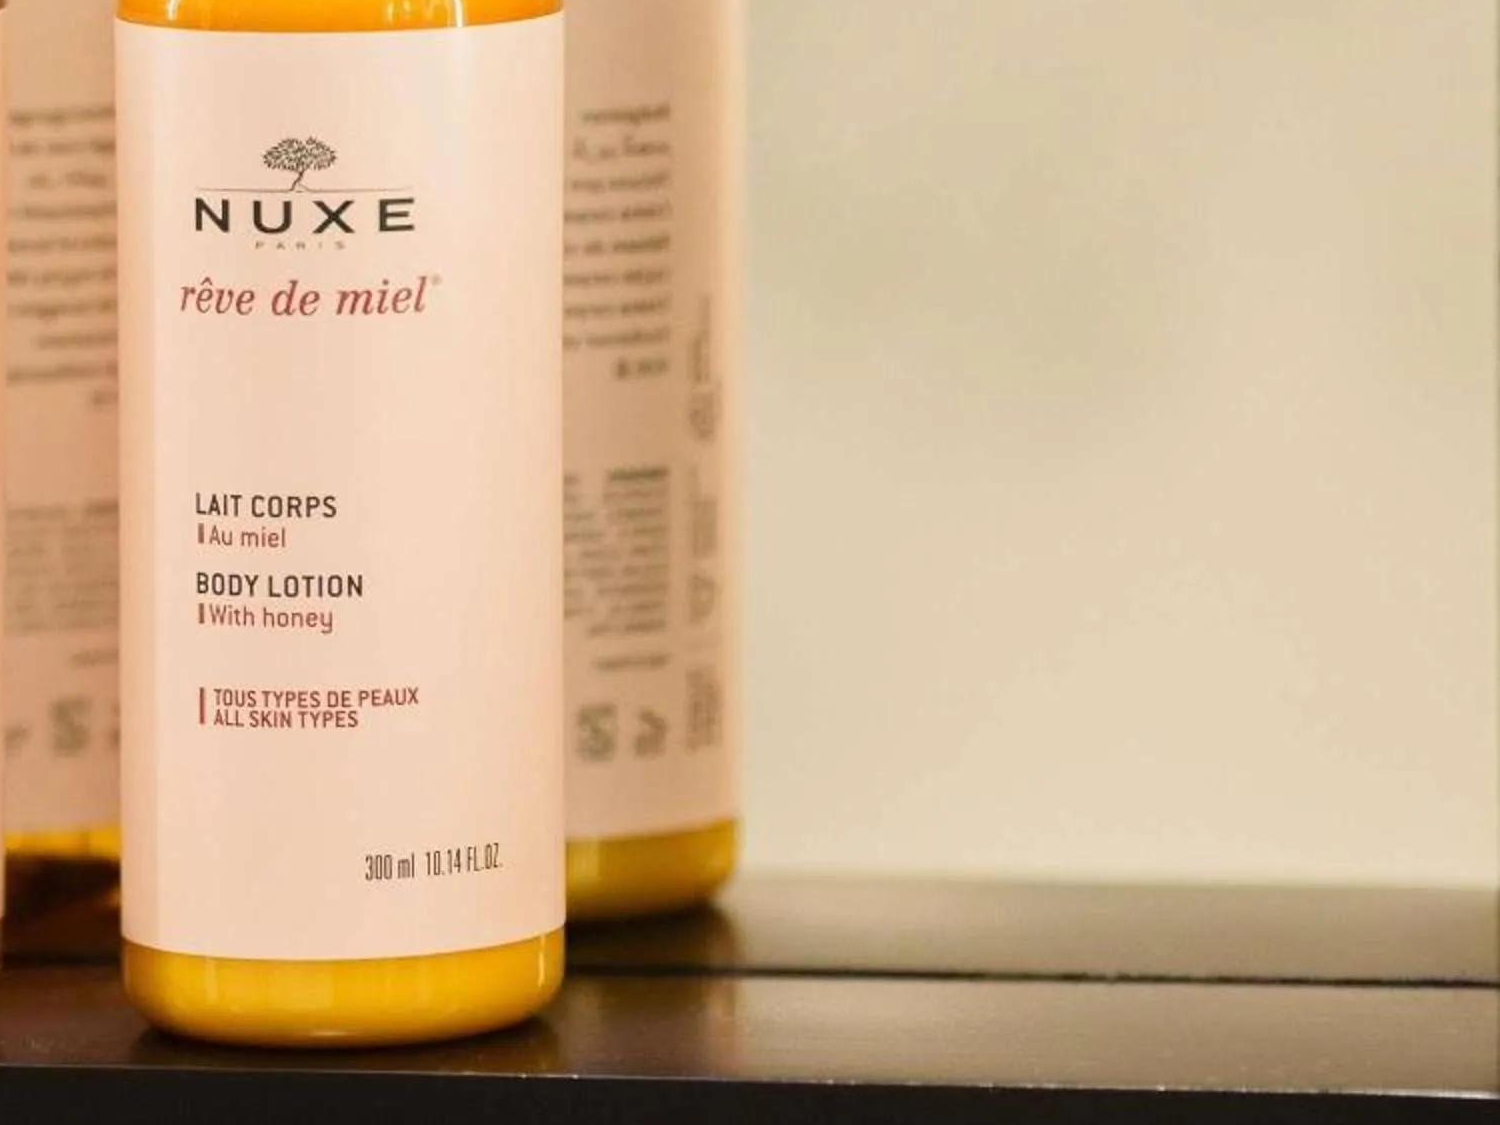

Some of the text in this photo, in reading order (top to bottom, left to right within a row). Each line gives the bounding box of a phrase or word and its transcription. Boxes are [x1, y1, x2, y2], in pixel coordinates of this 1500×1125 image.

[195, 197, 415, 234] NUXE
[255, 241, 345, 250] PARIS
[180, 277, 255, 315] rêve
[271, 280, 320, 316] de
[195, 492, 337, 519] LAIT CORPS
[209, 525, 286, 548] Au miel
[196, 572, 363, 598] BODY LOTION
[209, 604, 333, 634] With honey
[214, 687, 419, 709] TOUS TYPES DE PEAUX
[214, 710, 359, 728] ALL SKIN TYPES
[365, 855, 392, 881] 300
[398, 853, 415, 879] ml
[426, 848, 461, 876] 10.14
